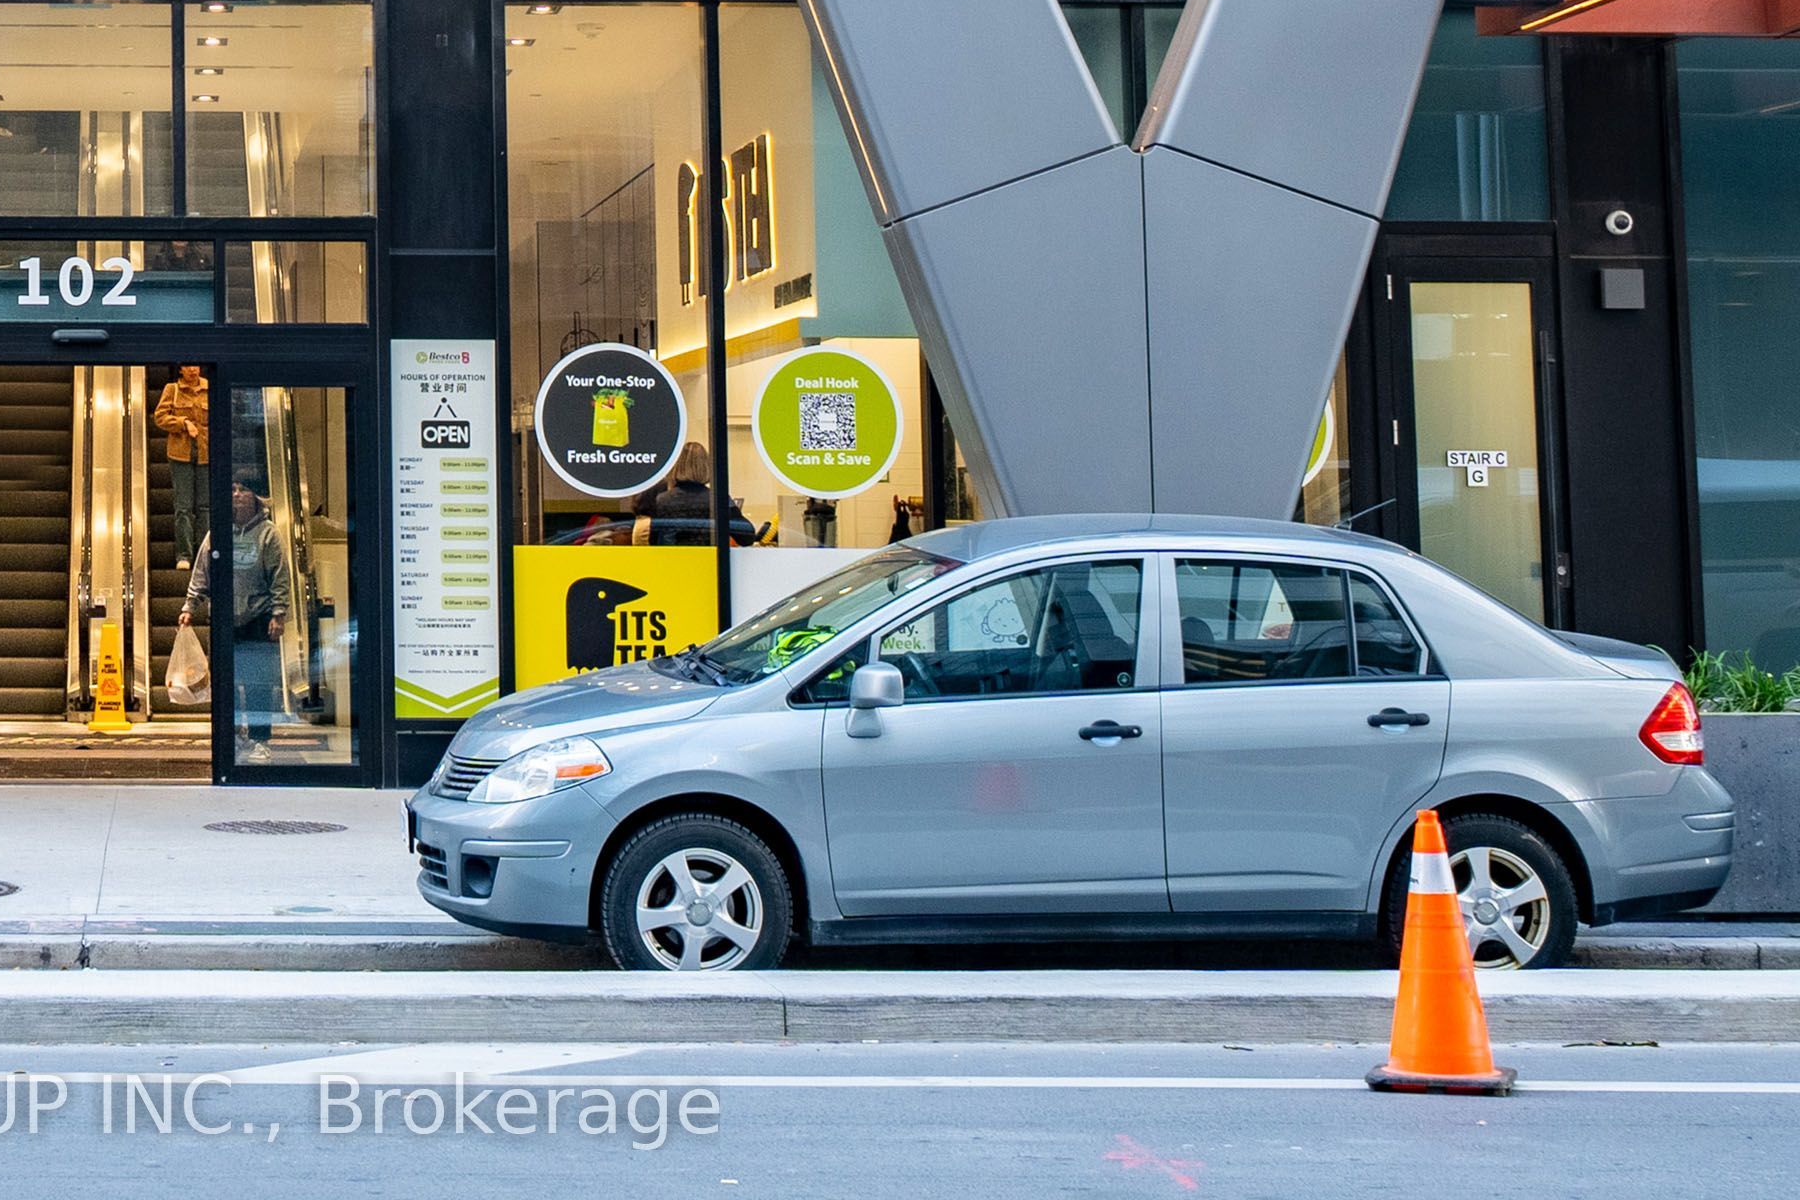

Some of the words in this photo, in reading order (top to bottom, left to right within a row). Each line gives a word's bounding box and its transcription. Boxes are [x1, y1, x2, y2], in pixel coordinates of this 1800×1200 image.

[18, 256, 137, 306] 102
[429, 351, 461, 361] Bestco
[400, 373, 429, 381] HOURS
[429, 373, 441, 381] OF
[565, 375, 595, 387] Your
[596, 375, 656, 390] One-Stop
[794, 377, 824, 388] Deal
[825, 377, 859, 388] Hook
[420, 382, 467, 393] 营业时间
[423, 425, 469, 443] OPEN
[567, 450, 607, 463] Fresh
[608, 450, 657, 463] Grocer
[786, 452, 821, 465] Scan
[823, 452, 835, 465] &
[837, 452, 871, 465] Save
[1449, 452, 1491, 465] STAIR
[1495, 452, 1505, 465] C
[1471, 469, 1485, 483] G
[620, 611, 667, 641] ITS
[882, 636, 926, 650] Week.
